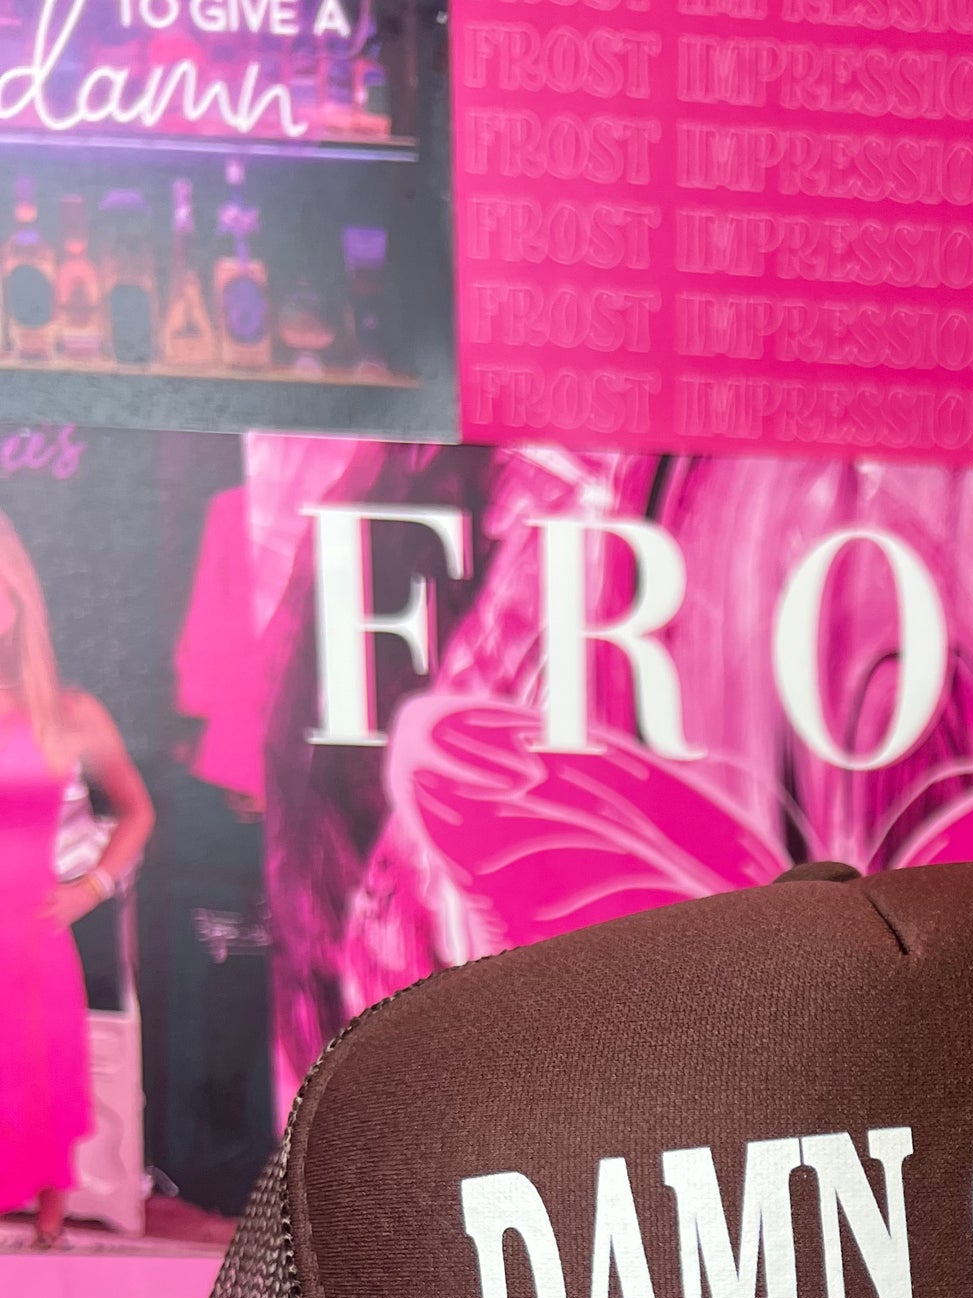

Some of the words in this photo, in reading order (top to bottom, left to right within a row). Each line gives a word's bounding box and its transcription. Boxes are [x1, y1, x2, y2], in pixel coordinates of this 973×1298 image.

[189, 0, 300, 35] GIVE
[313, 0, 350, 38] A
[0, 0, 308, 137] damn
[463, 20, 662, 99] FROST
[463, 107, 661, 185] FROST
[465, 195, 661, 270] FROST
[467, 282, 661, 354] FROST
[470, 362, 661, 434] FROST
